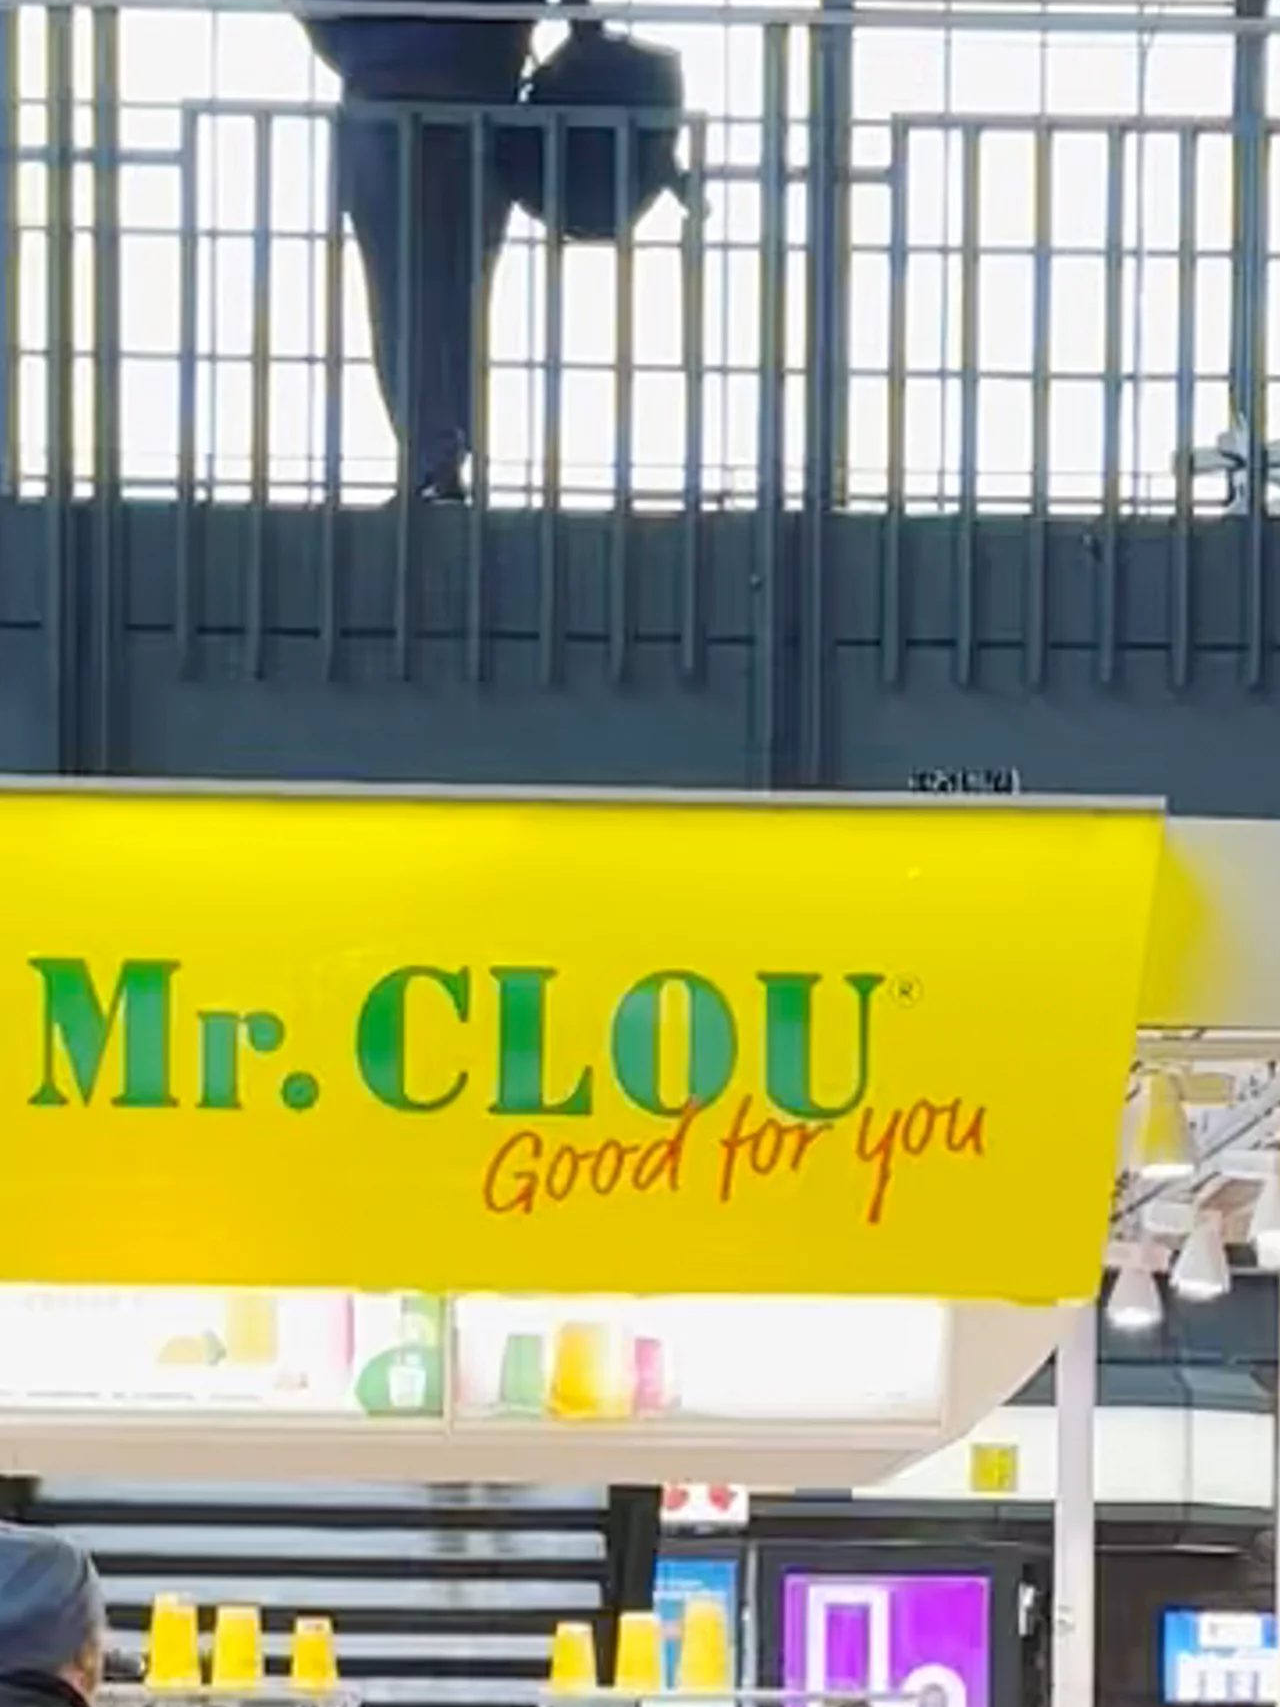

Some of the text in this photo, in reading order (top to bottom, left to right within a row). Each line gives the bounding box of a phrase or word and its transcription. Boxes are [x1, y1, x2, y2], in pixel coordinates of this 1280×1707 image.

[27, 957, 884, 1120] Mr. CLOU
[484, 1092, 986, 1224] Good for you
